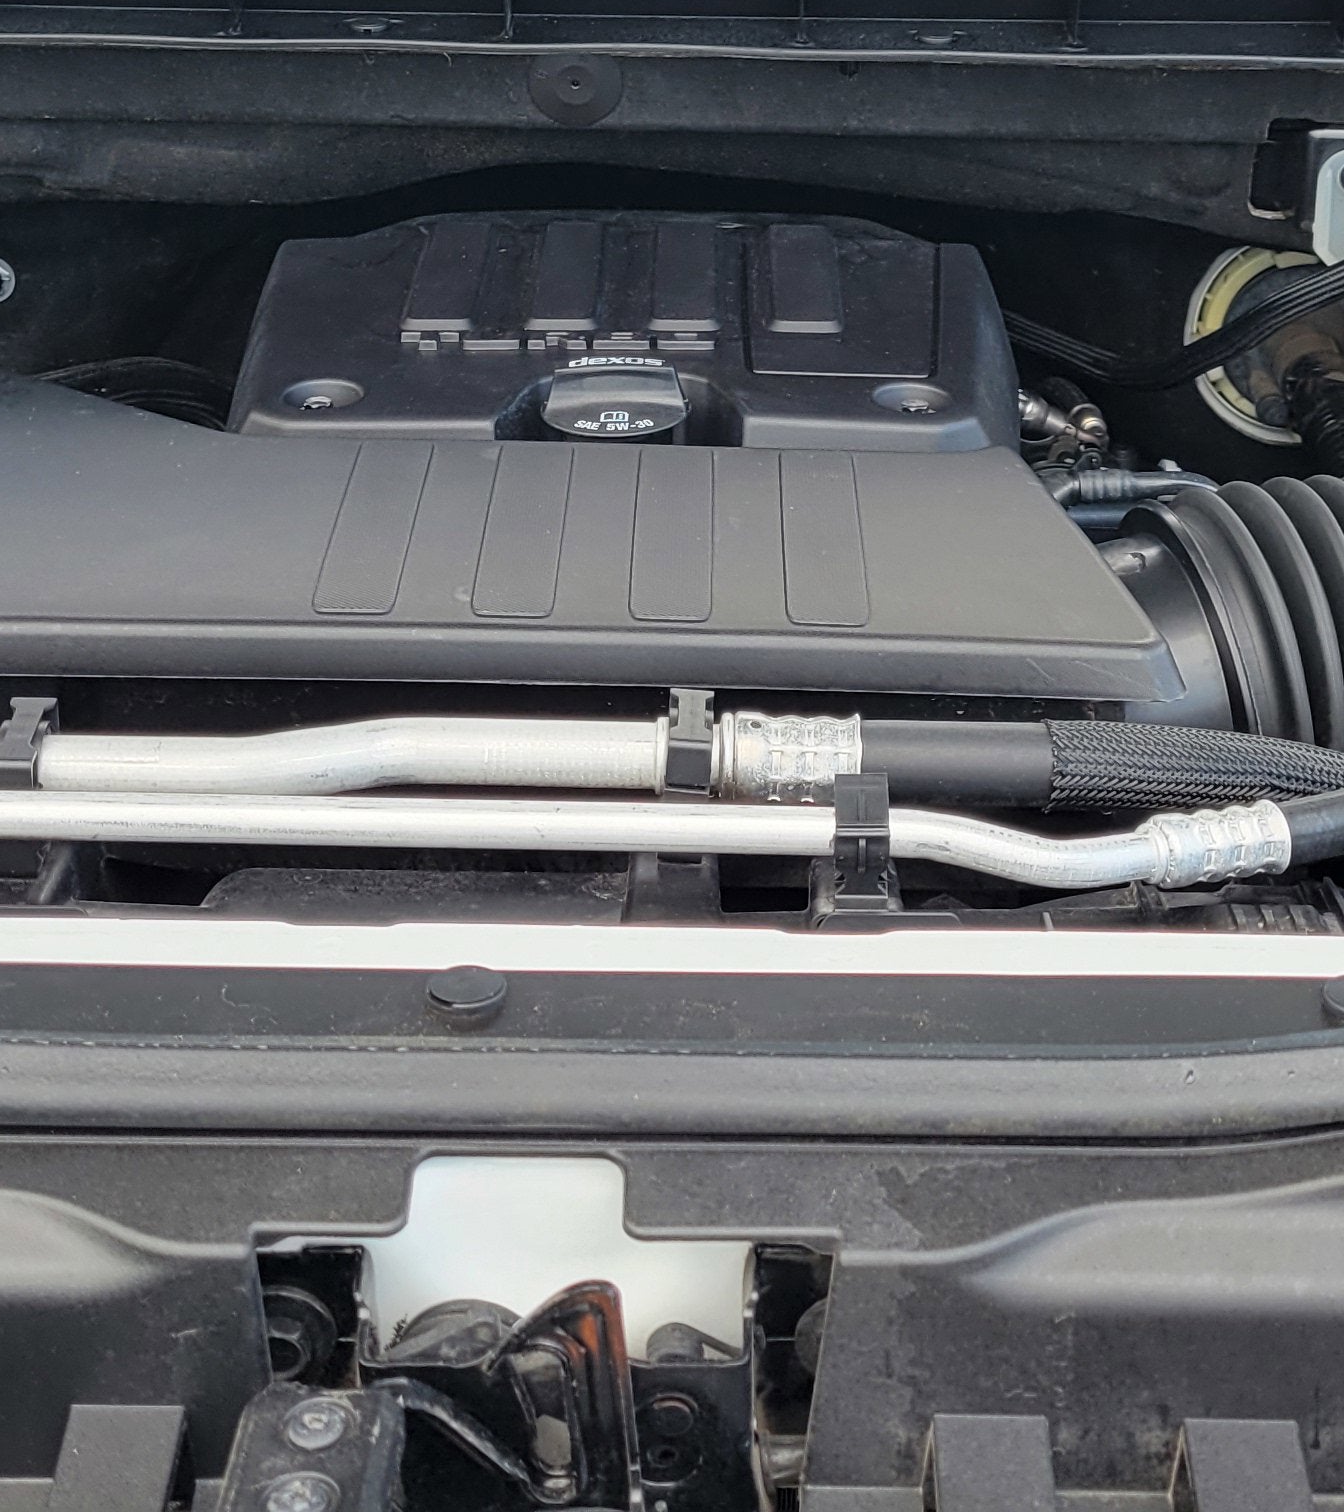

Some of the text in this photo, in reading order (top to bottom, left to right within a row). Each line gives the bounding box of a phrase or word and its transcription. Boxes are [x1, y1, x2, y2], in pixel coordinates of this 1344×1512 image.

[568, 356, 665, 368] dexos
[574, 419, 654, 431] SAE 5W-30
